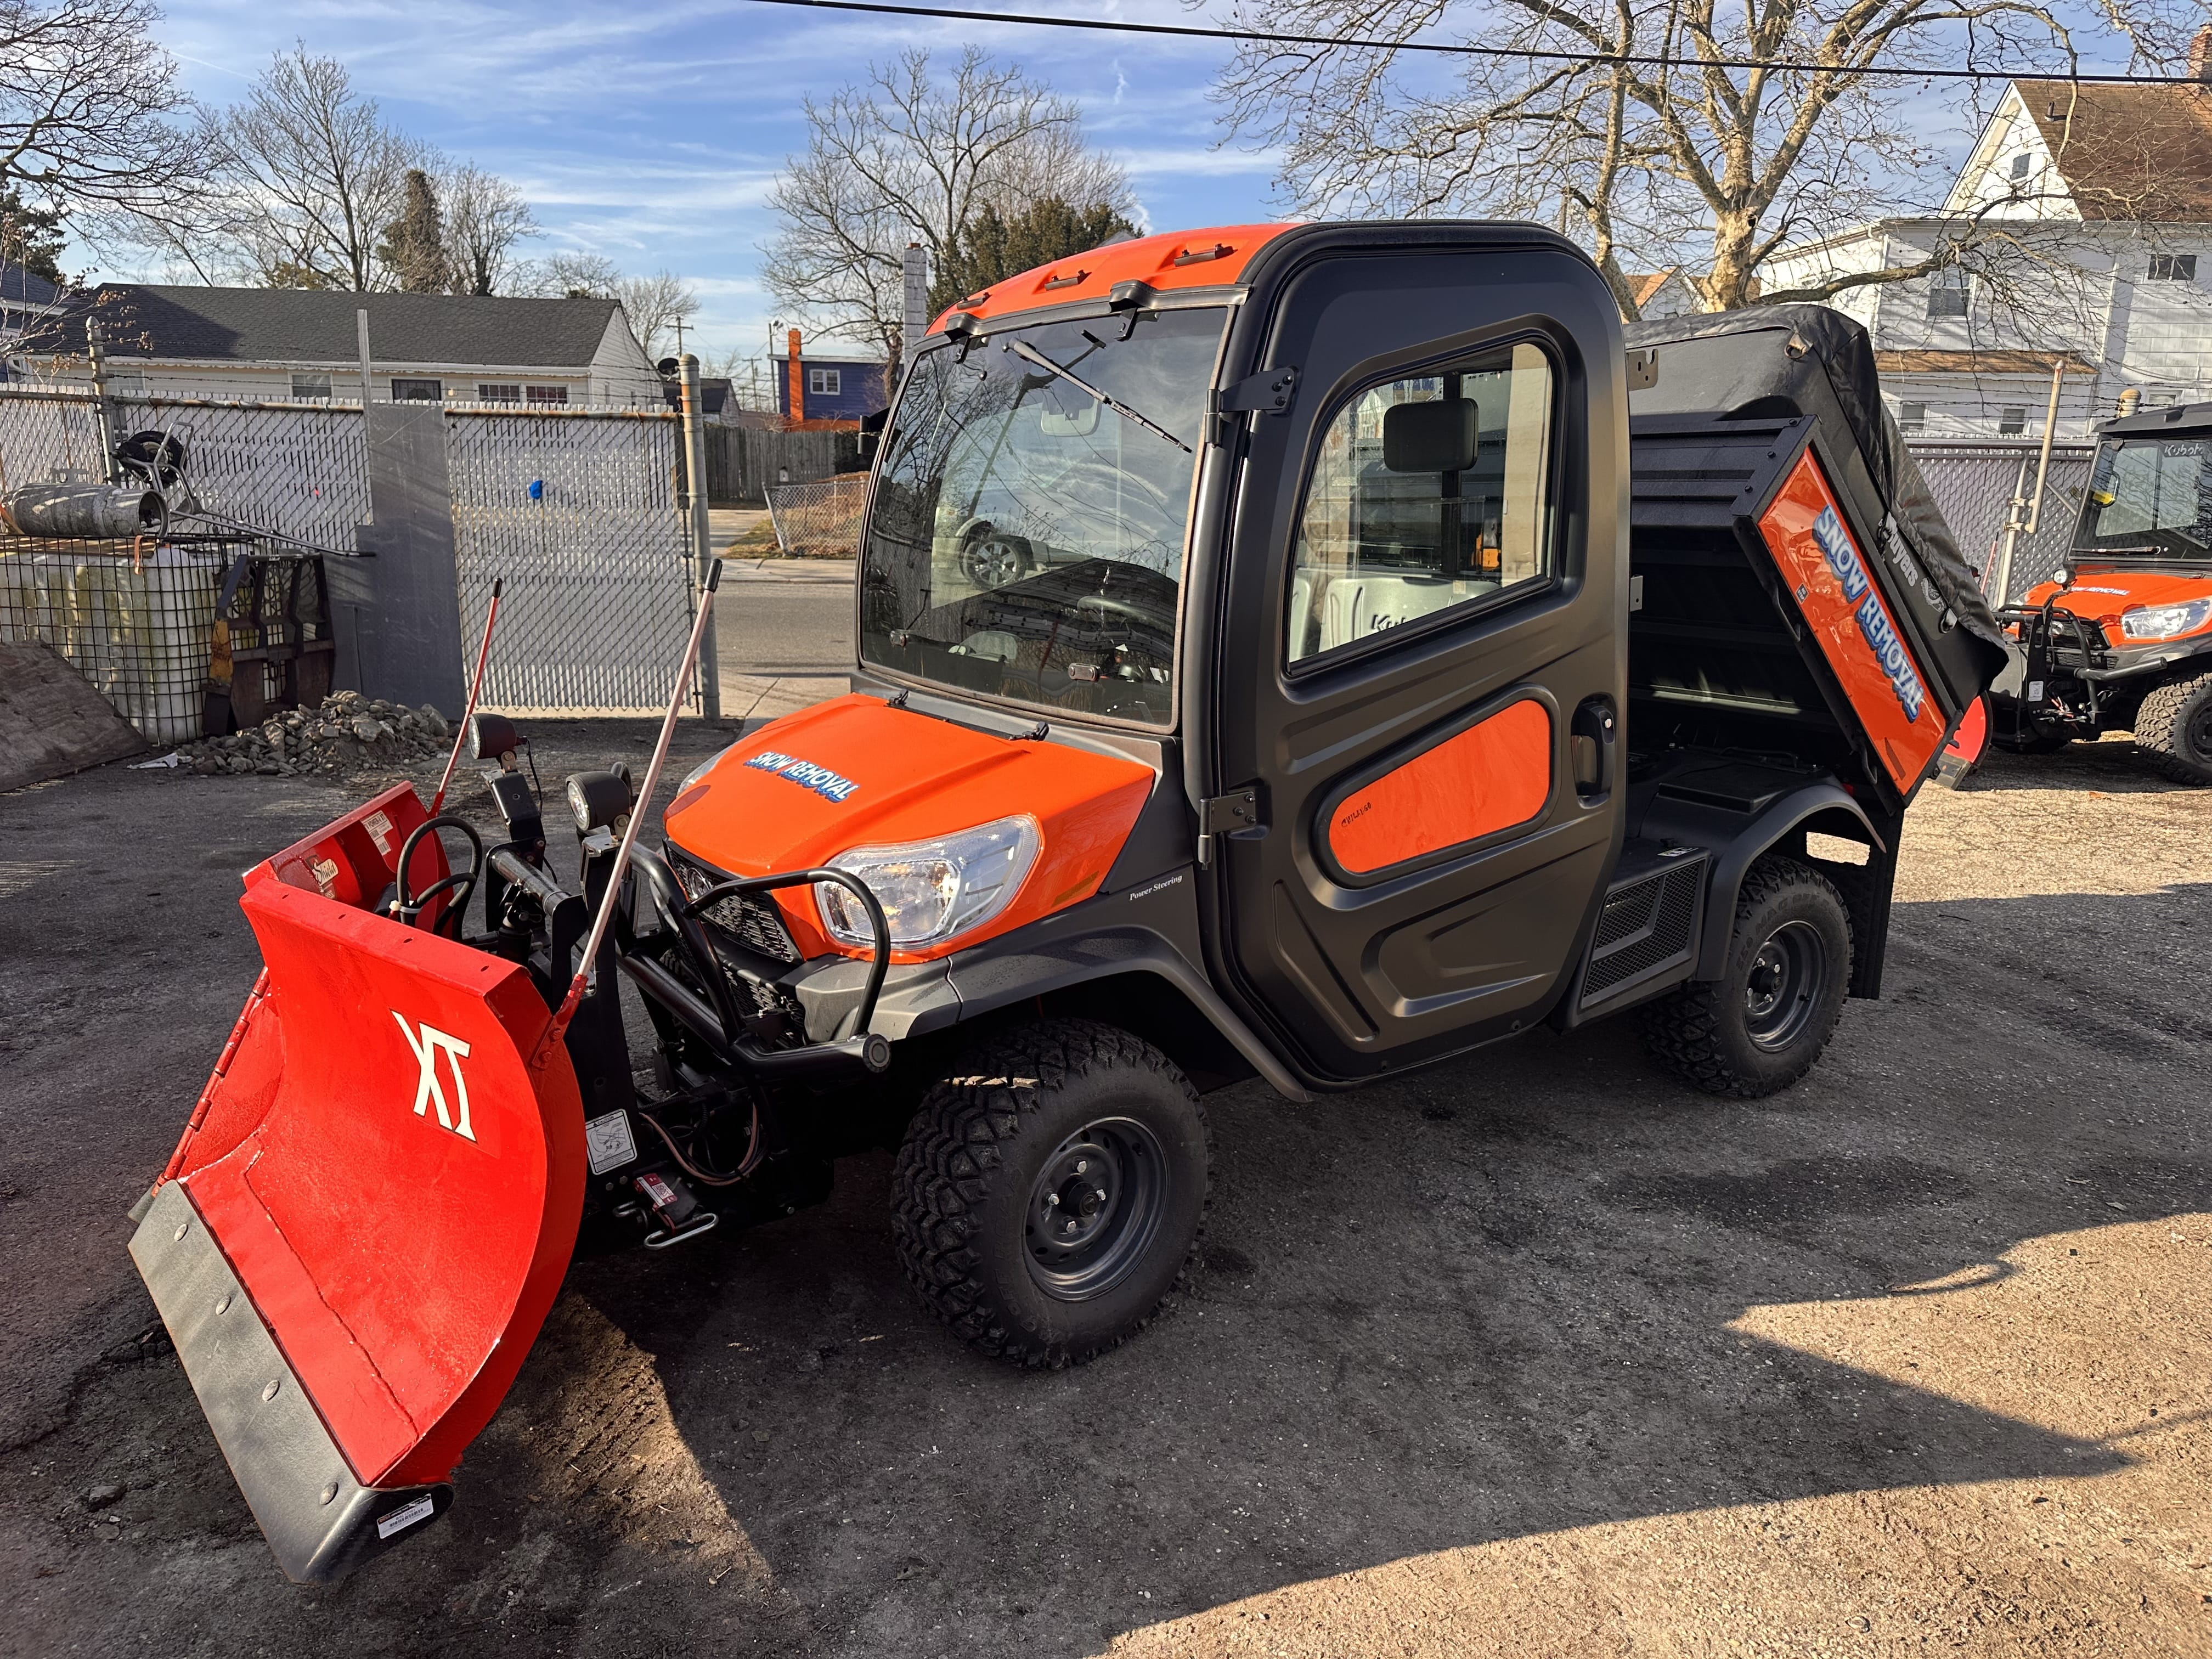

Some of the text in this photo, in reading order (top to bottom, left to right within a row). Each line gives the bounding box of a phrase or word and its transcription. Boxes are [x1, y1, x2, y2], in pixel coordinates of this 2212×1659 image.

[1885, 528, 1918, 588] uyers
[1812, 504, 1925, 724] SNOW REMOVAL
[743, 751, 861, 804] SNOW REMOVAL
[1129, 874, 1183, 901] Power Steering
[390, 1008, 479, 1144] XT
